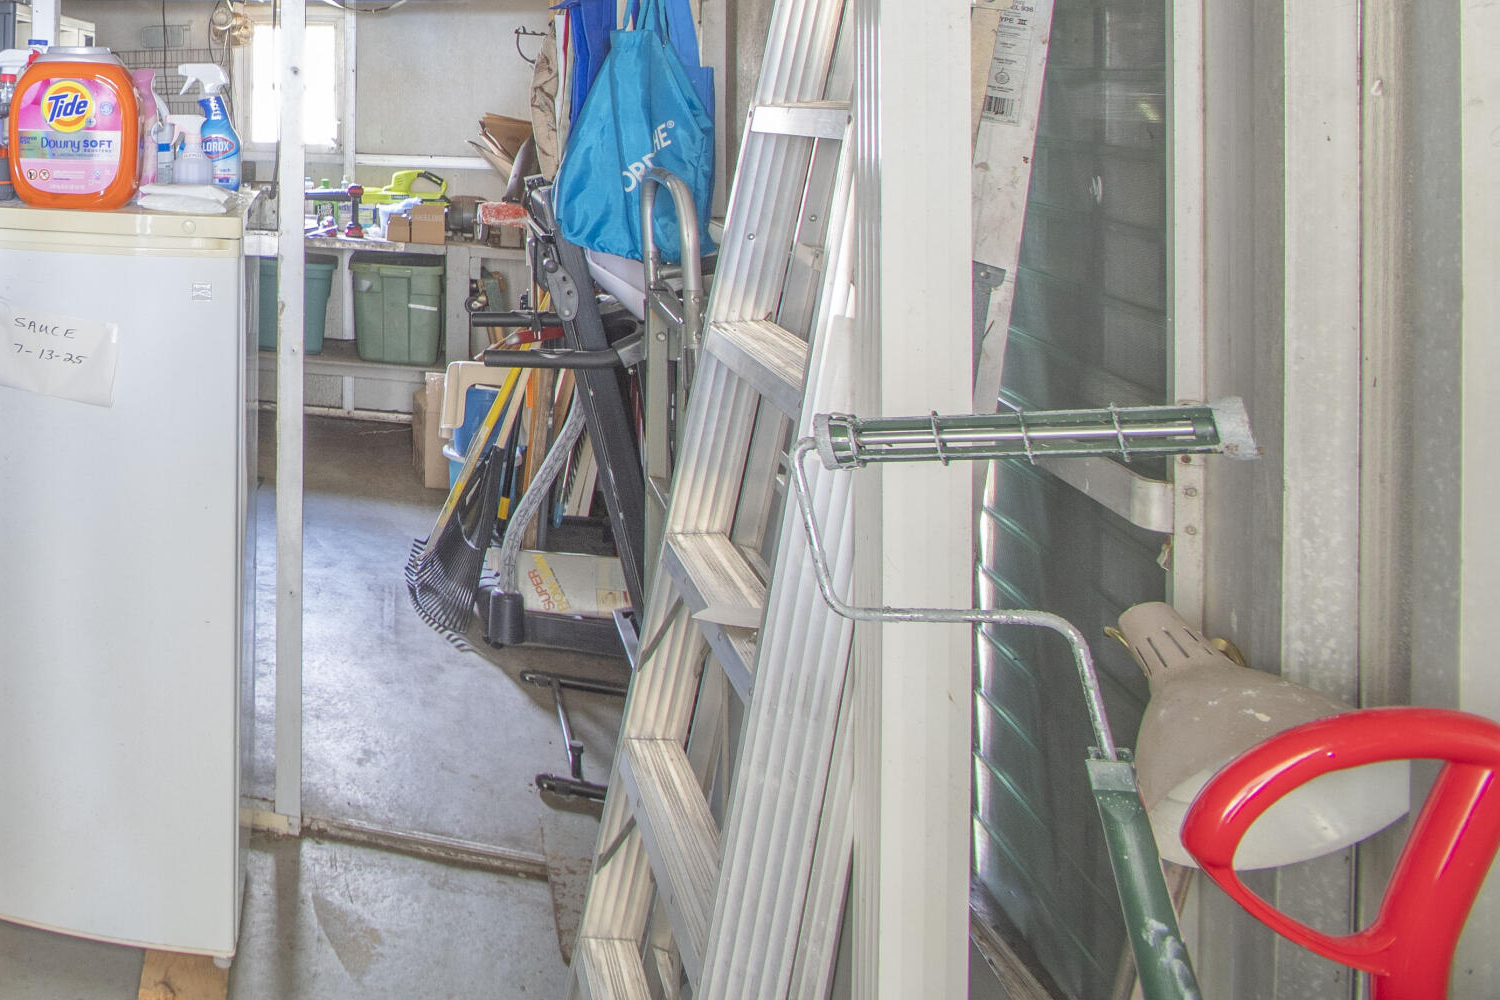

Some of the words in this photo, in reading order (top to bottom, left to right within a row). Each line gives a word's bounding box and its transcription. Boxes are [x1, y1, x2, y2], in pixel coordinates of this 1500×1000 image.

[48, 93, 89, 123] Tide
[41, 137, 80, 153] Downy
[83, 139, 113, 148] SOFT
[202, 141, 229, 152] LOROX
[14, 317, 77, 339] SAUCE
[14, 343, 87, 365] 7-13-25
[528, 569, 556, 611] SUPER
